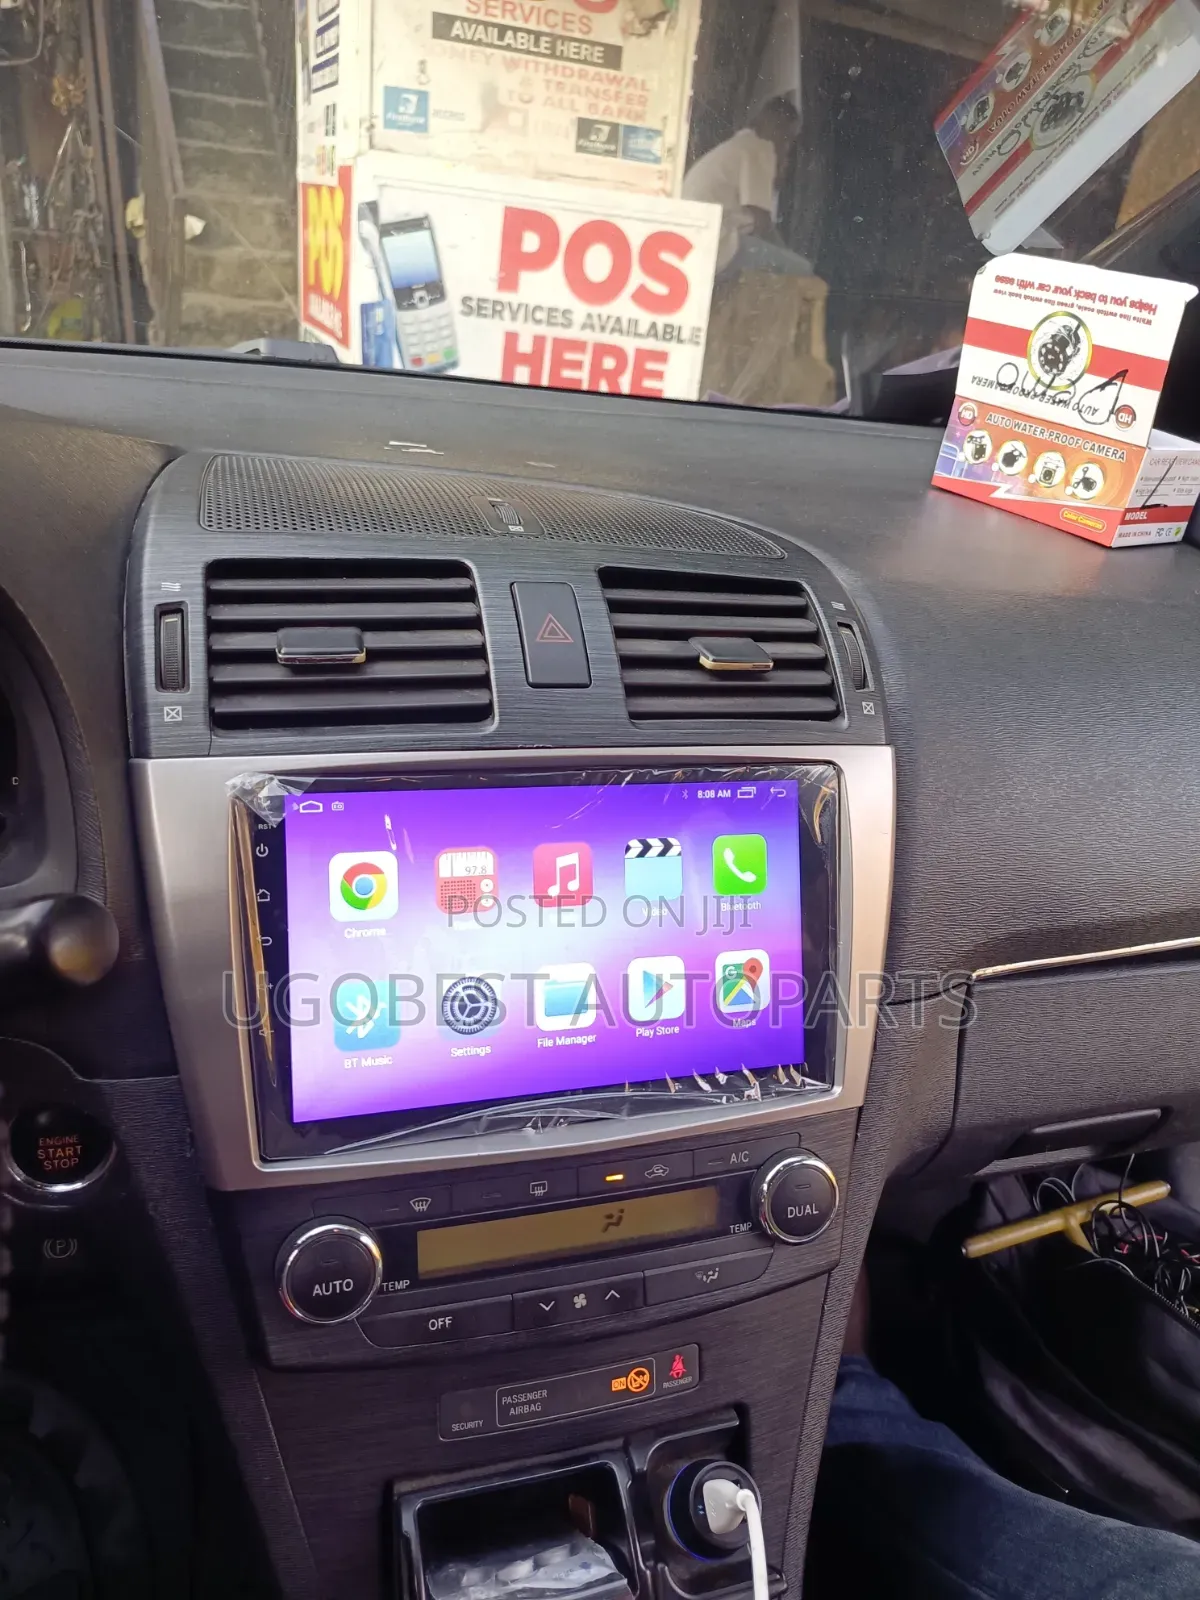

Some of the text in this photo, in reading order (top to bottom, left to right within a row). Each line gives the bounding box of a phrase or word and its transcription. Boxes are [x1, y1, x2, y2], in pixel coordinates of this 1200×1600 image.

[466, 0, 593, 35] SERVICES
[450, 20, 605, 63] AVAILABLE HERE
[502, 56, 651, 92] WITHDRAWAL
[543, 79, 649, 108] TRANSFER
[497, 206, 694, 316] POS
[1016, 278, 1035, 290] with
[1036, 282, 1051, 292] car
[1052, 285, 1073, 299] your
[1098, 292, 1108, 305] to
[1110, 294, 1129, 308] you
[1129, 299, 1159, 316] Helps
[460, 296, 705, 346] SERVICES AVAILABLE
[501, 331, 669, 398] HERE
[1071, 401, 1100, 416] AUTO
[1119, 415, 1133, 425] HD
[985, 412, 1127, 461] AUTO WATER-PROOF CAMERA
[1124, 511, 1148, 521] MODEL
[697, 789, 731, 799] 8:08 AM
[464, 865, 488, 876] 97.8
[344, 928, 387, 939] Chrome
[732, 1017, 757, 1029] Maps
[635, 1025, 680, 1039] Play Store
[537, 1032, 597, 1049] File Manager
[450, 1044, 491, 1058] Settings
[343, 1055, 393, 1069] BT Music
[39, 1134, 80, 1146] ENGINE
[37, 1145, 83, 1160] START
[729, 1151, 750, 1164] A/C
[43, 1158, 79, 1171] STOP
[787, 1204, 819, 1219] DUAL
[729, 1222, 753, 1234] TEMP
[312, 1278, 354, 1297] AUTO
[382, 1279, 410, 1292] TEMP
[428, 1316, 453, 1331] OFF
[662, 1375, 693, 1389] PASSENGER
[501, 1389, 548, 1406] PASSENGER
[508, 1402, 542, 1416] AIRBAG
[451, 1419, 484, 1432] SECURITY
